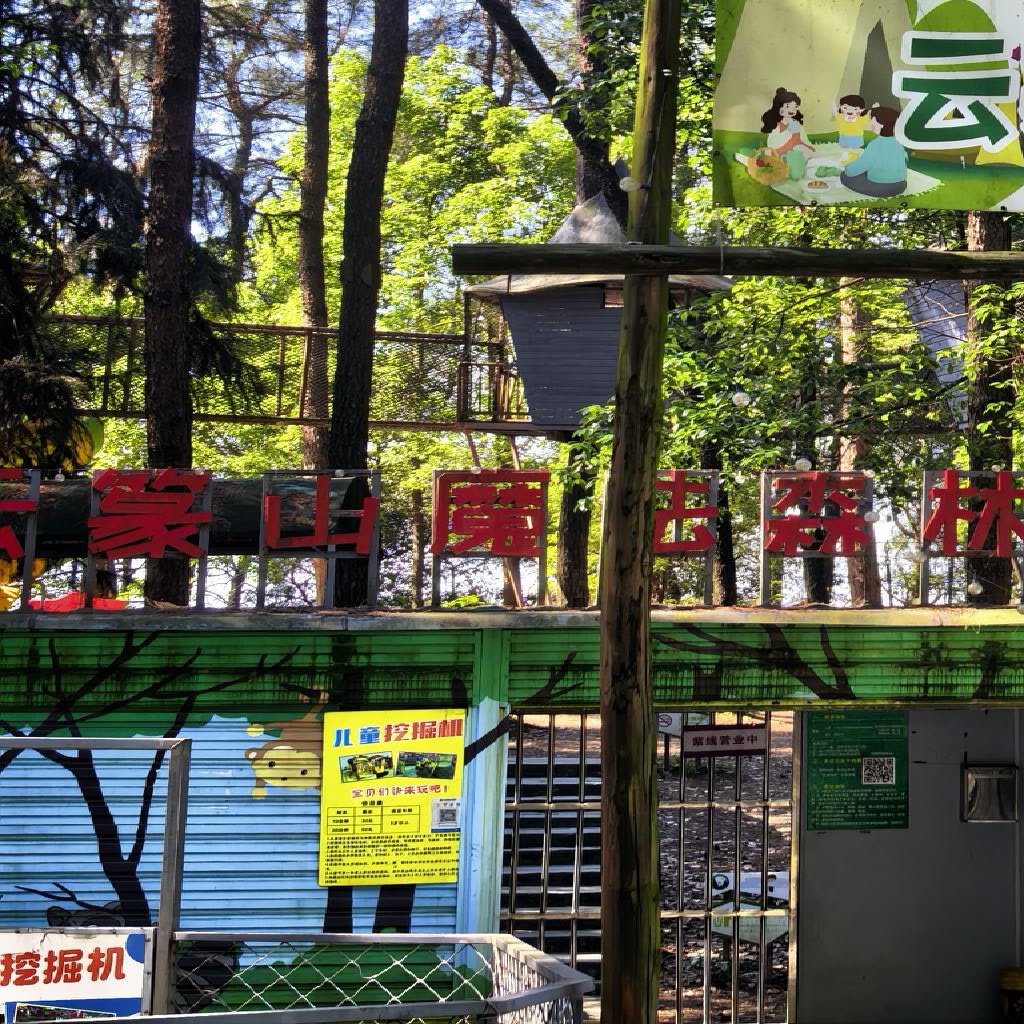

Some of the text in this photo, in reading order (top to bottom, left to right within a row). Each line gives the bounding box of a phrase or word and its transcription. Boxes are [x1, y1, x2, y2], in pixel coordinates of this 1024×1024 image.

[333, 718, 464, 748] 儿童挖掘机
[0, 947, 126, 986] 挖掘机
